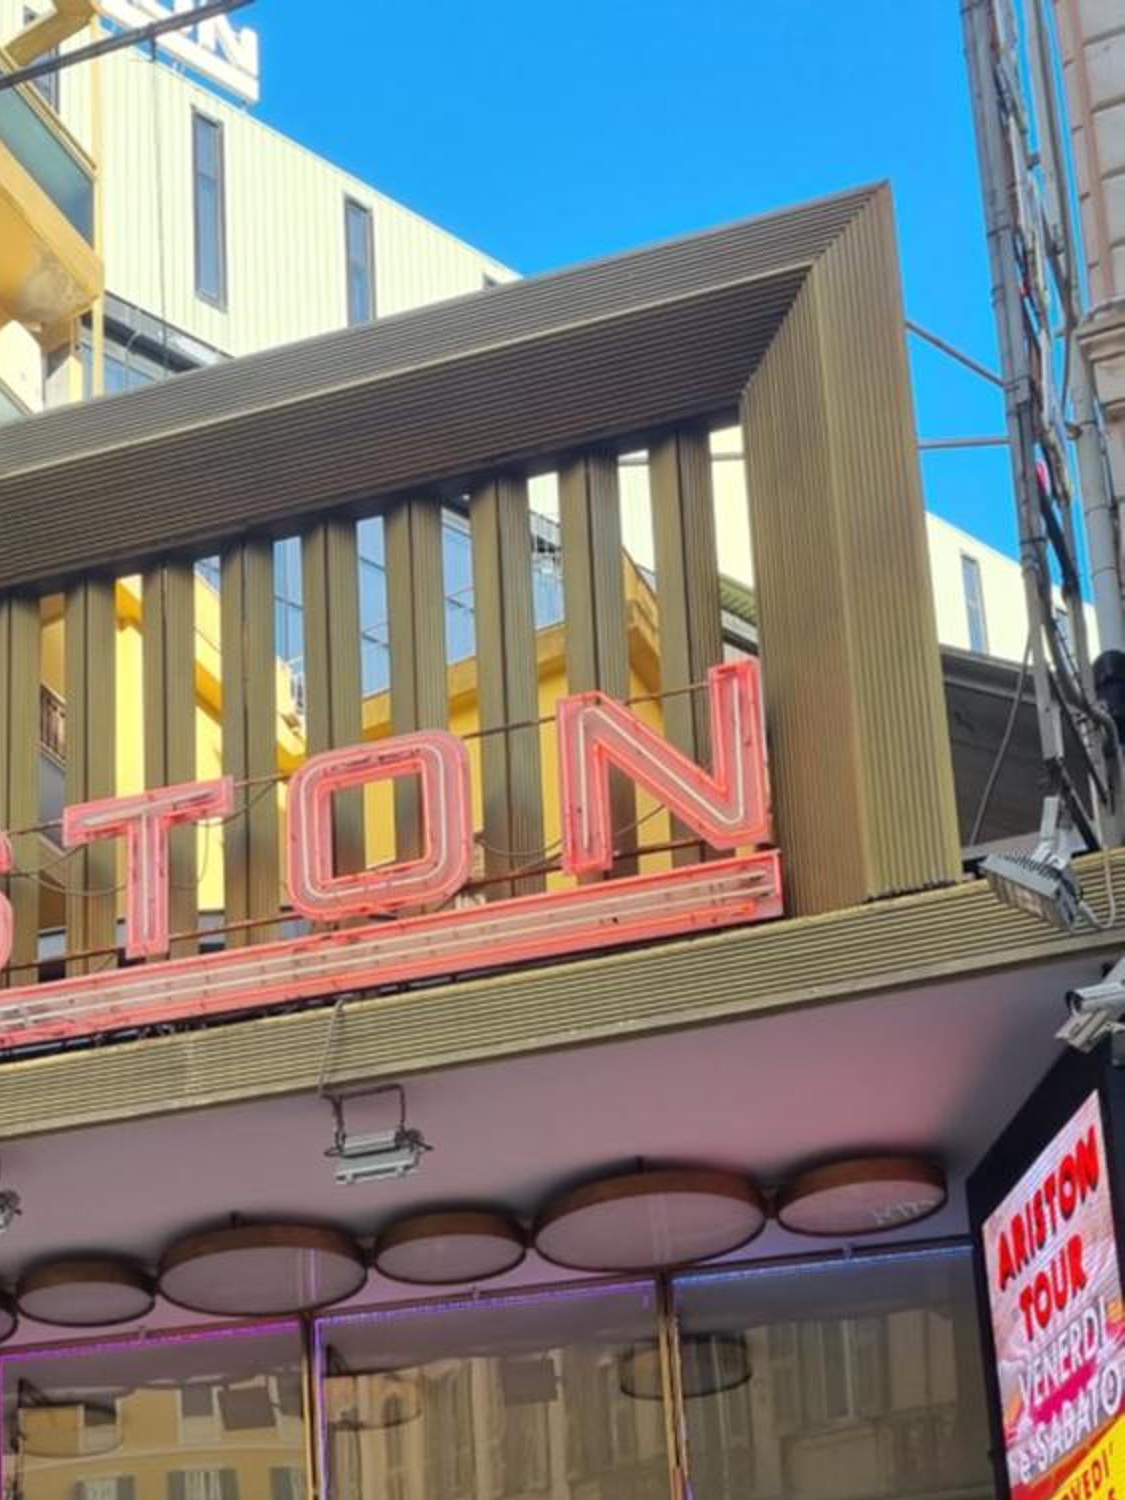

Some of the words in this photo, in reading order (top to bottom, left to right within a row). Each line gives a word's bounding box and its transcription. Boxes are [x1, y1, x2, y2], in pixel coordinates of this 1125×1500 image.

[998, 1124, 1100, 1292] ARISTON
[1019, 1234, 1089, 1342] TOUR
[1036, 1361, 1122, 1470] SABATO
